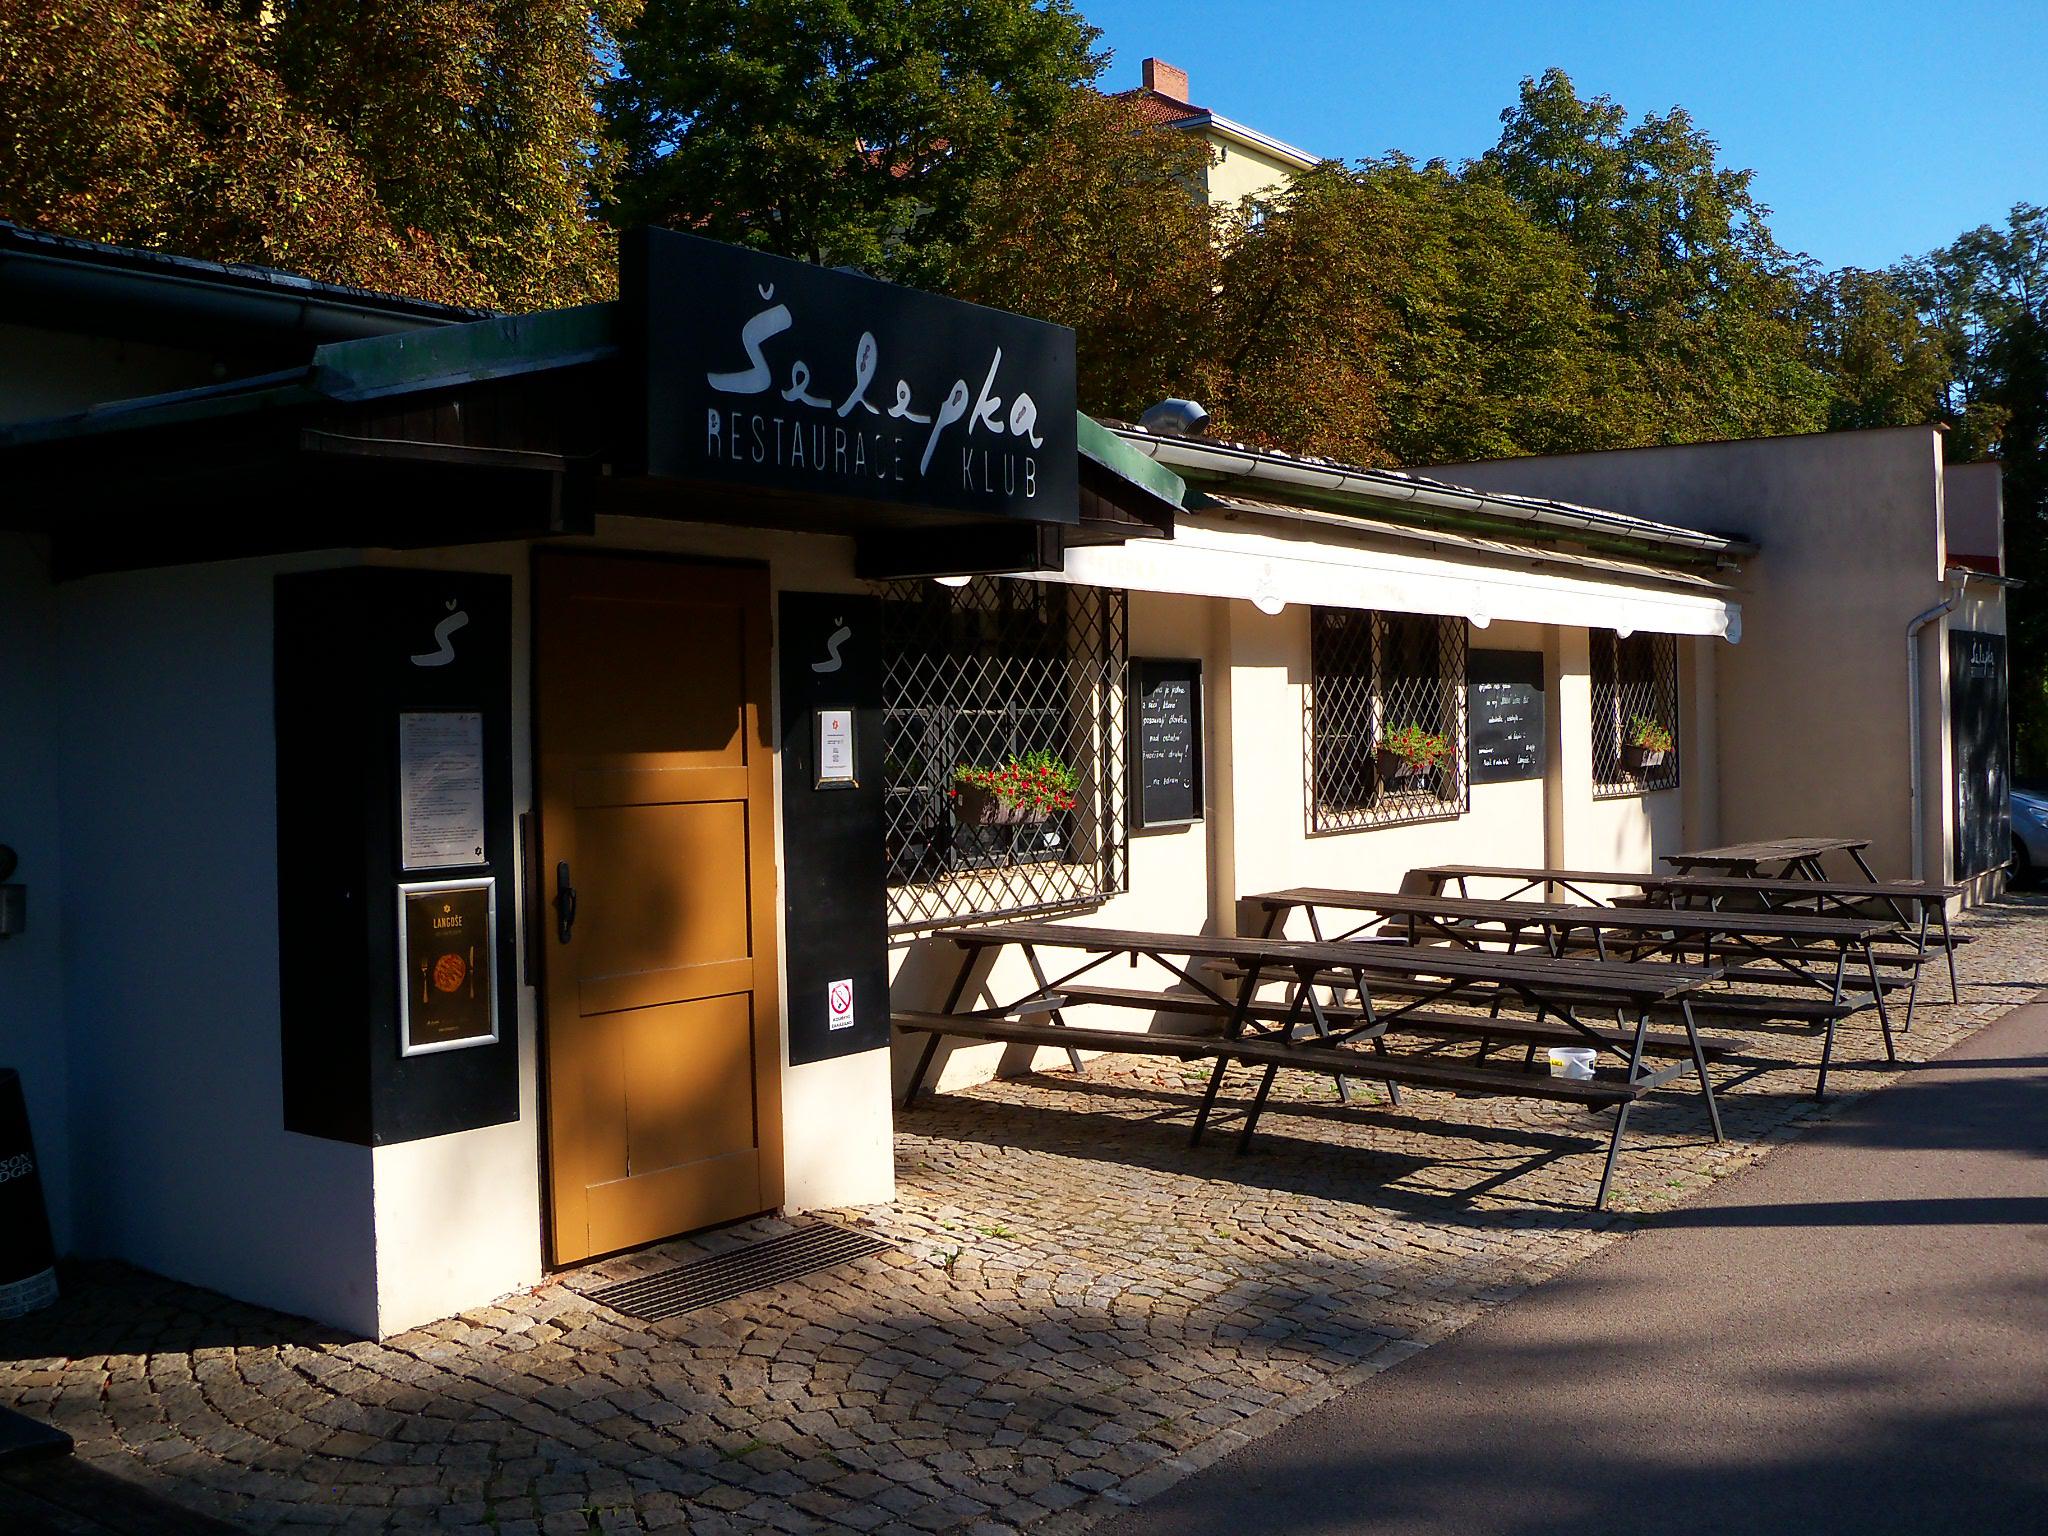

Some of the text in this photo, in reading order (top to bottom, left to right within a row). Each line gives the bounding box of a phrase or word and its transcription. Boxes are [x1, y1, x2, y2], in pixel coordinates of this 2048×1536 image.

[706, 282, 1044, 477] Šelepka
[708, 408, 1037, 498] RESTAURACE KLUB
[410, 598, 469, 667] Š
[811, 616, 852, 673] Š
[433, 915, 463, 929] LANGOŠE
